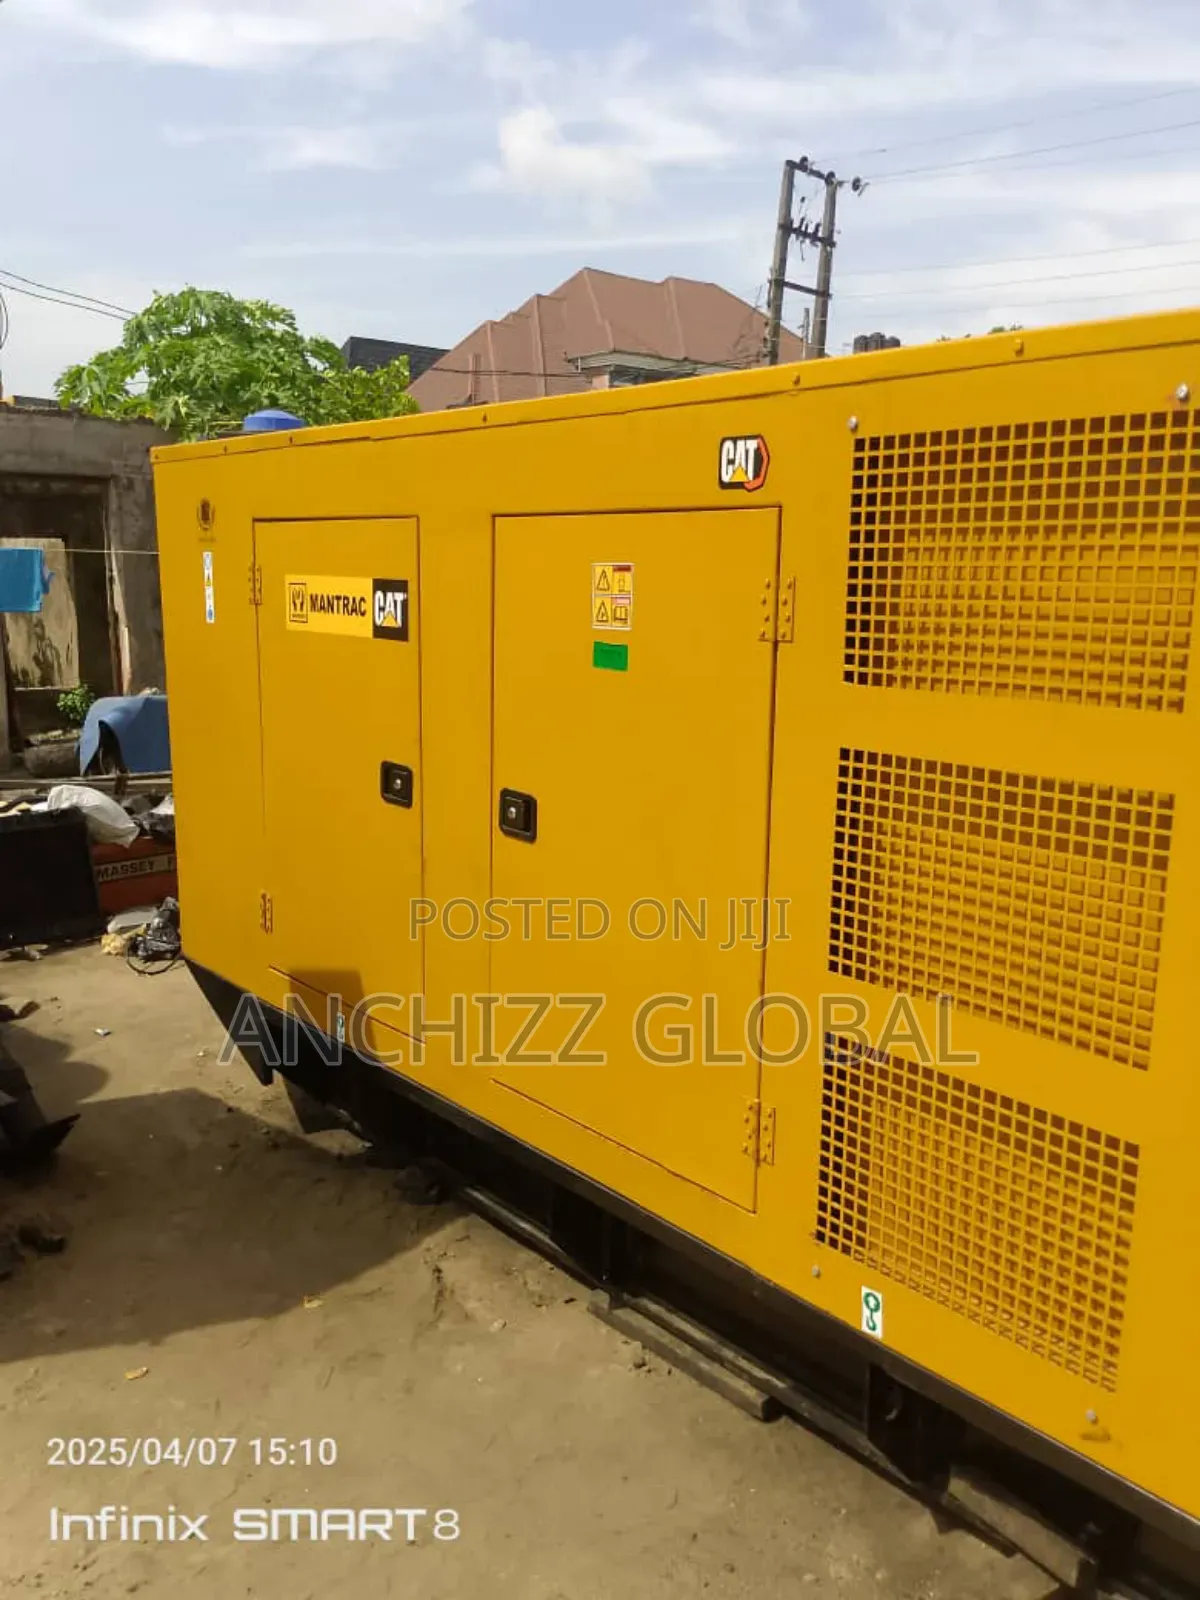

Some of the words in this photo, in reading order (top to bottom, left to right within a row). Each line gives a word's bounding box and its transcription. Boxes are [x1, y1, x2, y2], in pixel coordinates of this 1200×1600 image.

[720, 438, 758, 483] CAT
[309, 593, 367, 617] MANTRAC
[373, 590, 406, 628] CAT
[97, 860, 154, 880] MASSEY
